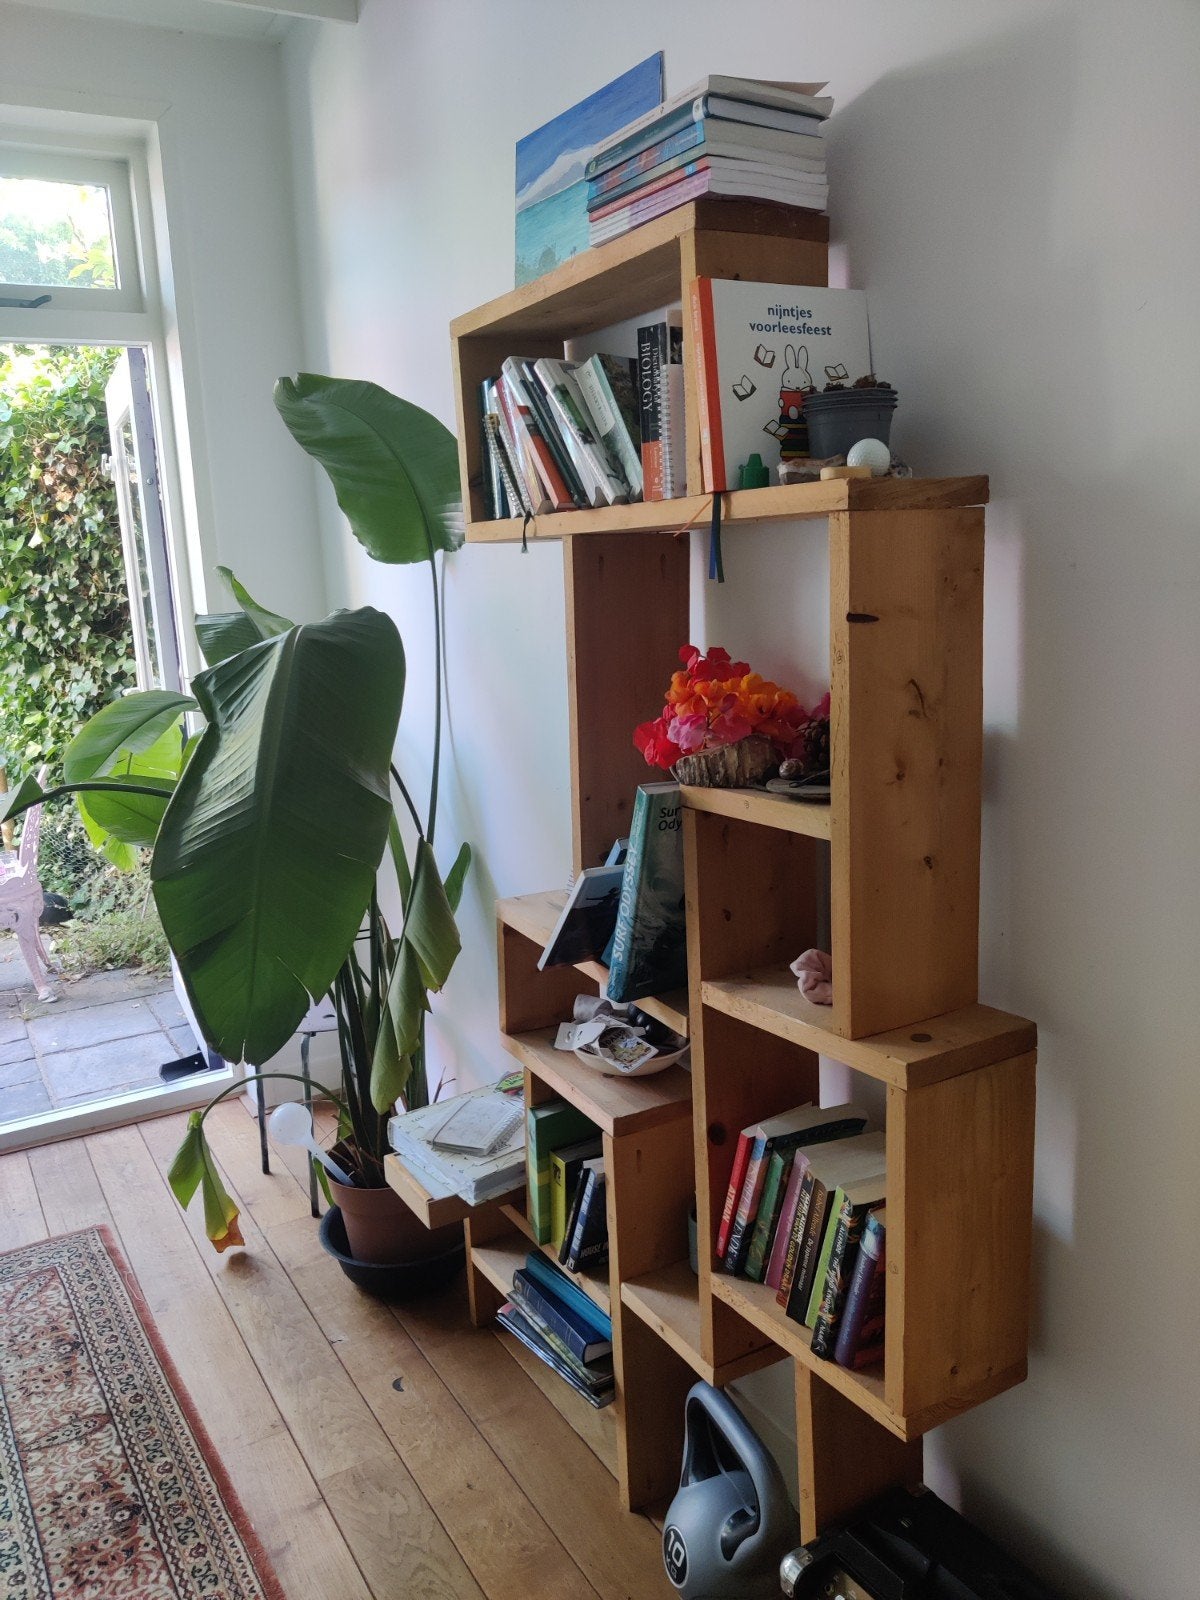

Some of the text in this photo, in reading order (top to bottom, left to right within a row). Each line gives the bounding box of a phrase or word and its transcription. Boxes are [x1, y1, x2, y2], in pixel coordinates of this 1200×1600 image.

[767, 303, 812, 321] nijntjes
[749, 321, 832, 336] voorleesfeest
[640, 341, 652, 411] BIOLOGY
[658, 817, 682, 831] Ody
[659, 806, 681, 819] Sur
[612, 919, 626, 961] SURF
[619, 848, 637, 916] ODYSSEY
[722, 1184, 736, 1221] ATMAN
[795, 1213, 806, 1244] ALLENDE
[834, 1224, 845, 1254] ALLENDE
[785, 1240, 795, 1269] GOUDEN
[780, 1268, 790, 1292] DRAAK
[823, 1287, 833, 1314] KNOWS
[668, 1530, 685, 1568] 10
